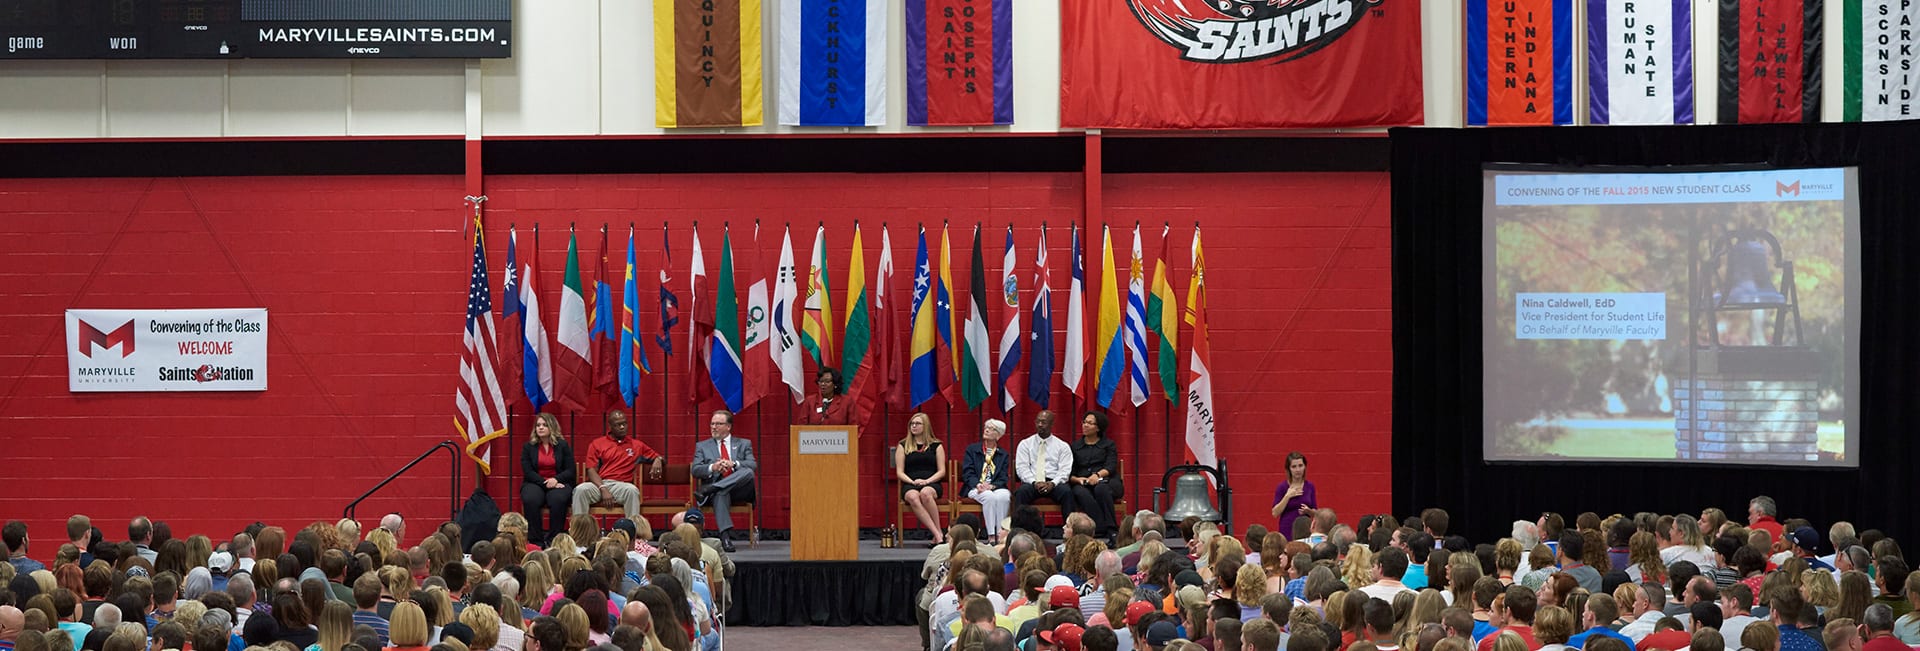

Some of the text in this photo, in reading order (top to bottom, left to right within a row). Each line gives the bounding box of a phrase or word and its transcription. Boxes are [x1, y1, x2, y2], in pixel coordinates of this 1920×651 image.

[8, 37, 44, 52] game
[109, 37, 137, 49] won
[259, 28, 494, 42] MARYVILLESAINTS.COM
[702, 0, 713, 87] QUINCY
[827, 0, 839, 108] CKHURST
[944, 6, 955, 79] SAINT
[963, 0, 976, 93] OSEPHS
[1186, 0, 1352, 60] SAINTS
[1505, 2, 1516, 88] UTHERN
[1624, 2, 1636, 74] RUMAN
[1755, 0, 1767, 77] LLIAM
[1879, 5, 1888, 105] SCONSIN
[1901, 0, 1911, 115] PARKSIDE
[1525, 12, 1536, 113] INDIANA
[1645, 25, 1655, 97] STATE
[1776, 23, 1787, 108] JEWELL
[1507, 184, 1751, 197] CONVENING OF THE FALL 2015 NEW STUDENT CLASS
[150, 319, 261, 335] Convening of the Class
[1522, 298, 1616, 309] Nina Caldwell, EdD
[1522, 312, 1664, 321] Vice President for Student Life
[1522, 325, 1660, 337] On Behalf of Maryville Faculty
[78, 367, 136, 376] MARYVILLE
[159, 366, 254, 381] Saints Nation
[177, 341, 233, 356] WELCOME
[1189, 389, 1215, 438] MARYV
